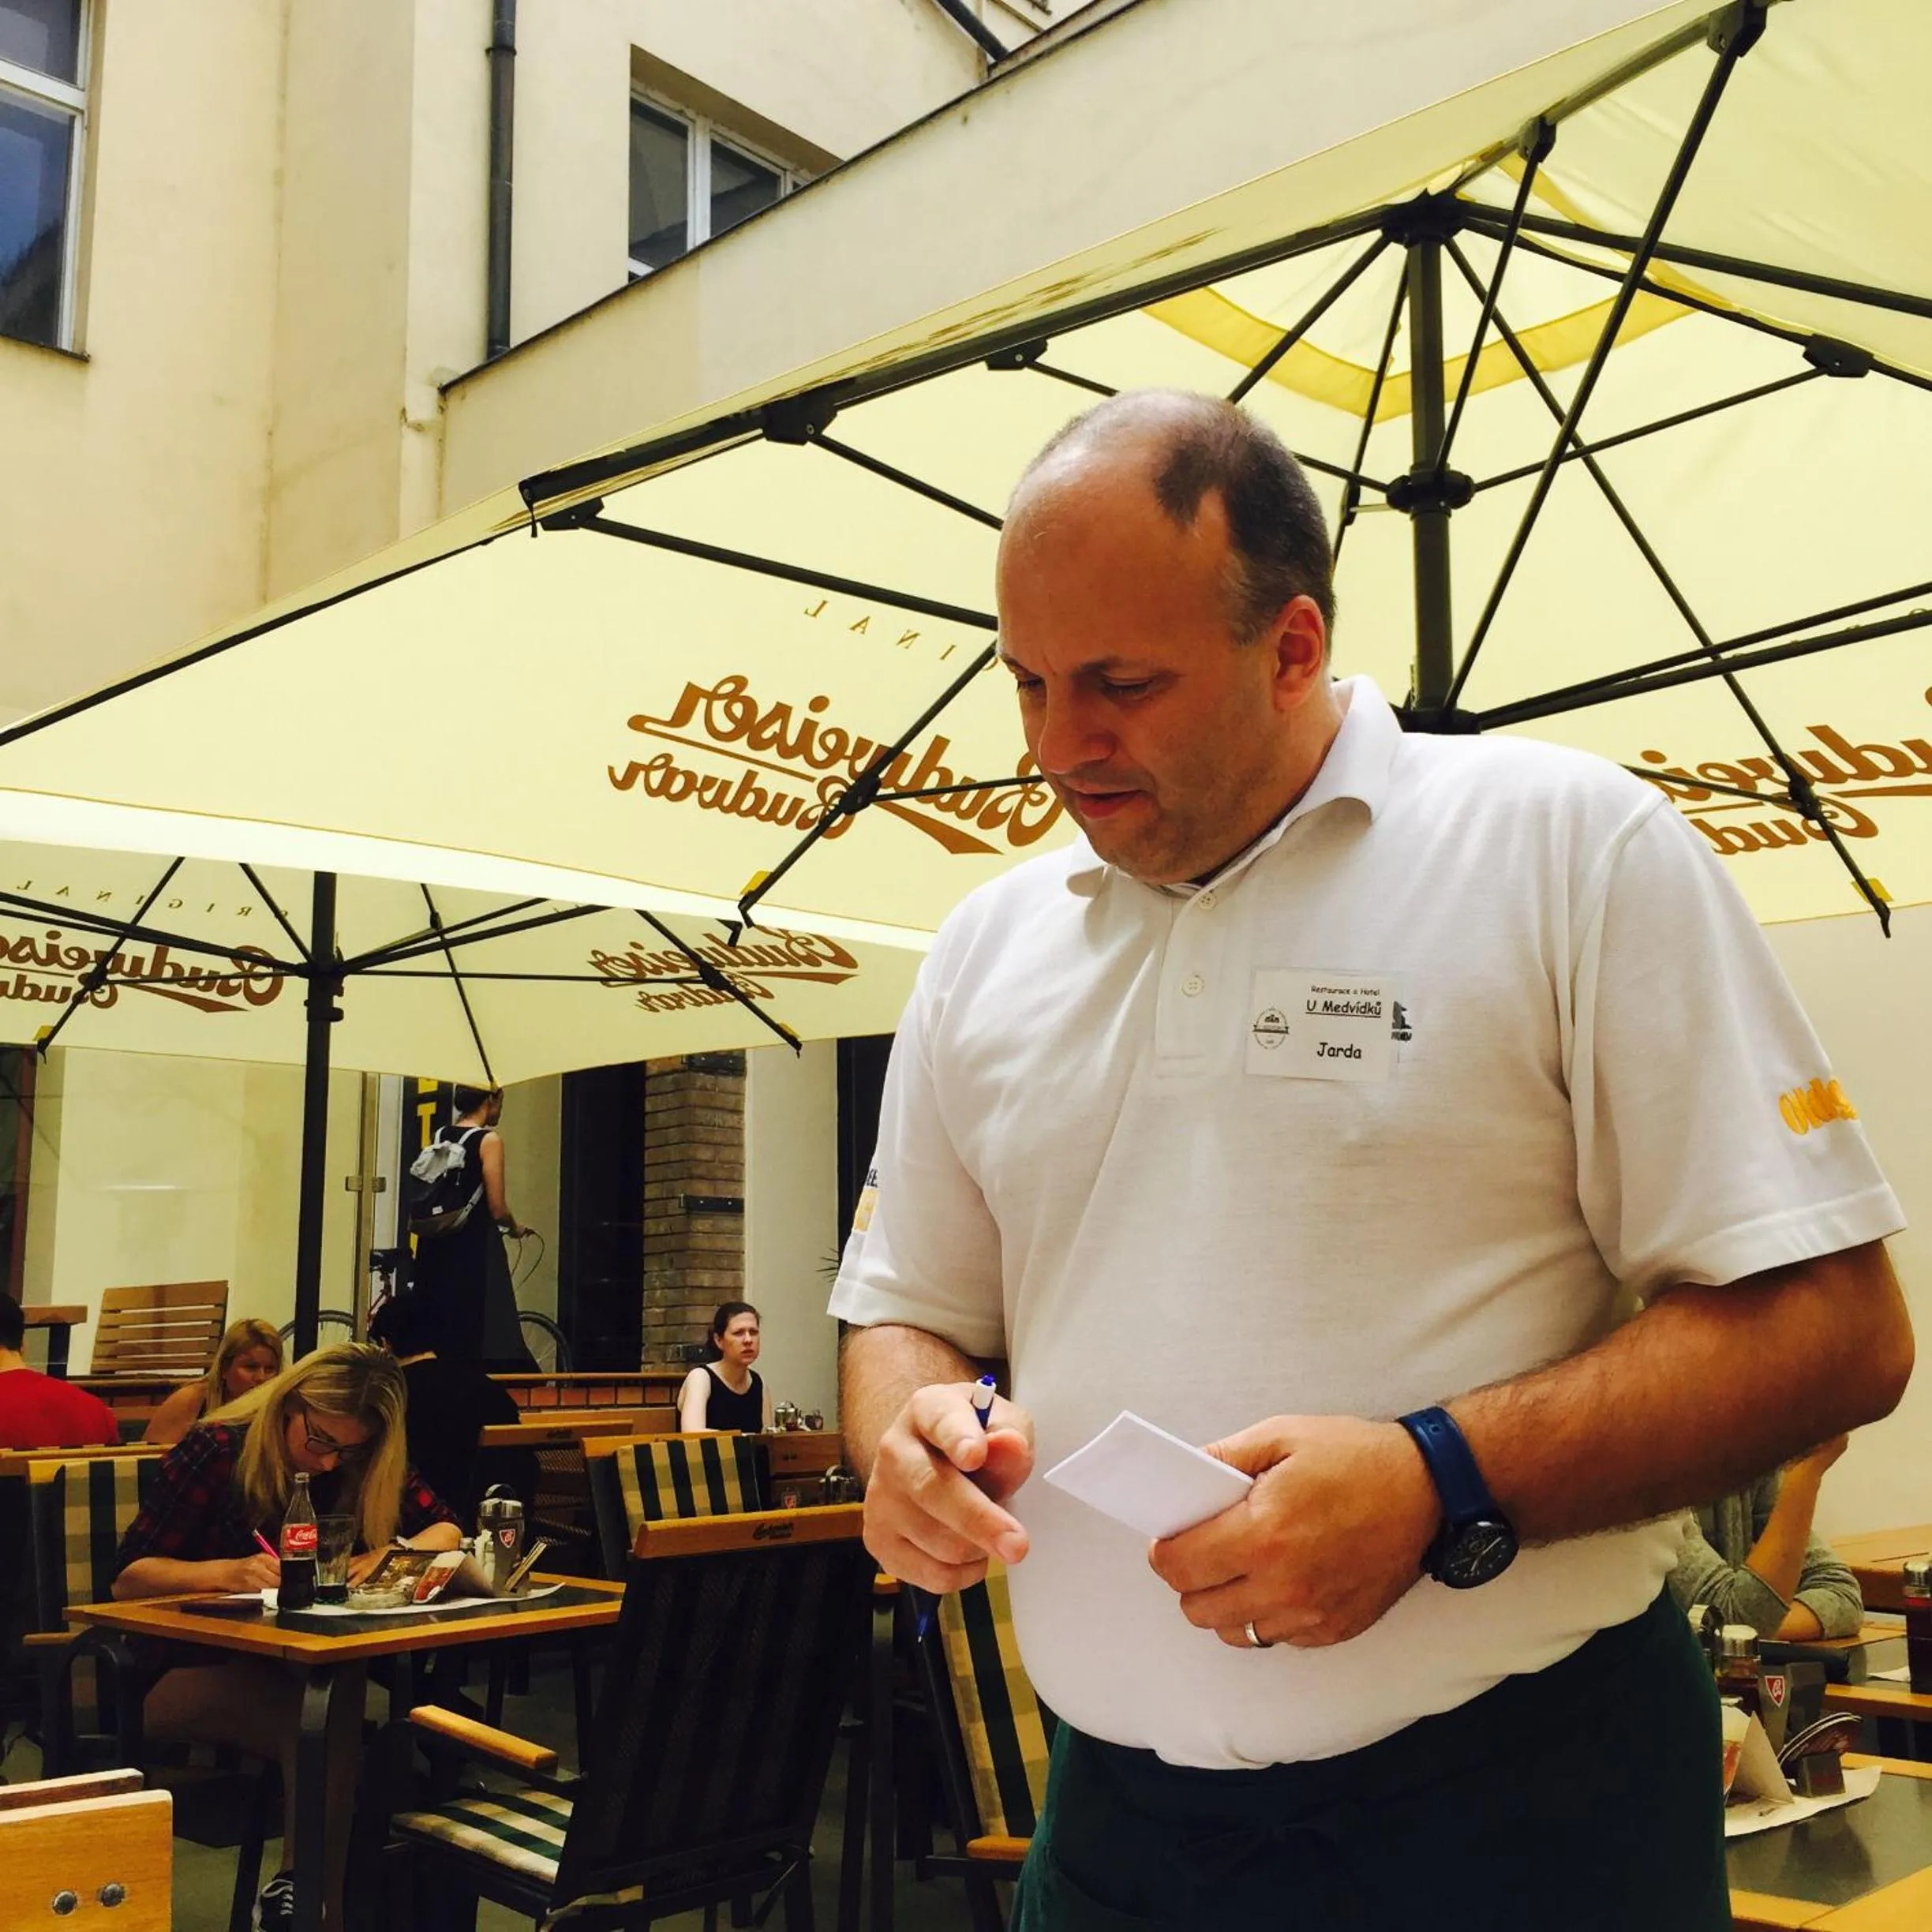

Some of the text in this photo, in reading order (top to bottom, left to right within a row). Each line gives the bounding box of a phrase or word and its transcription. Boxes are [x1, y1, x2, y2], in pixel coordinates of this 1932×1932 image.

[1306, 999, 1382, 1015] U Medvídků
[1316, 1042, 1362, 1059] Jarda
